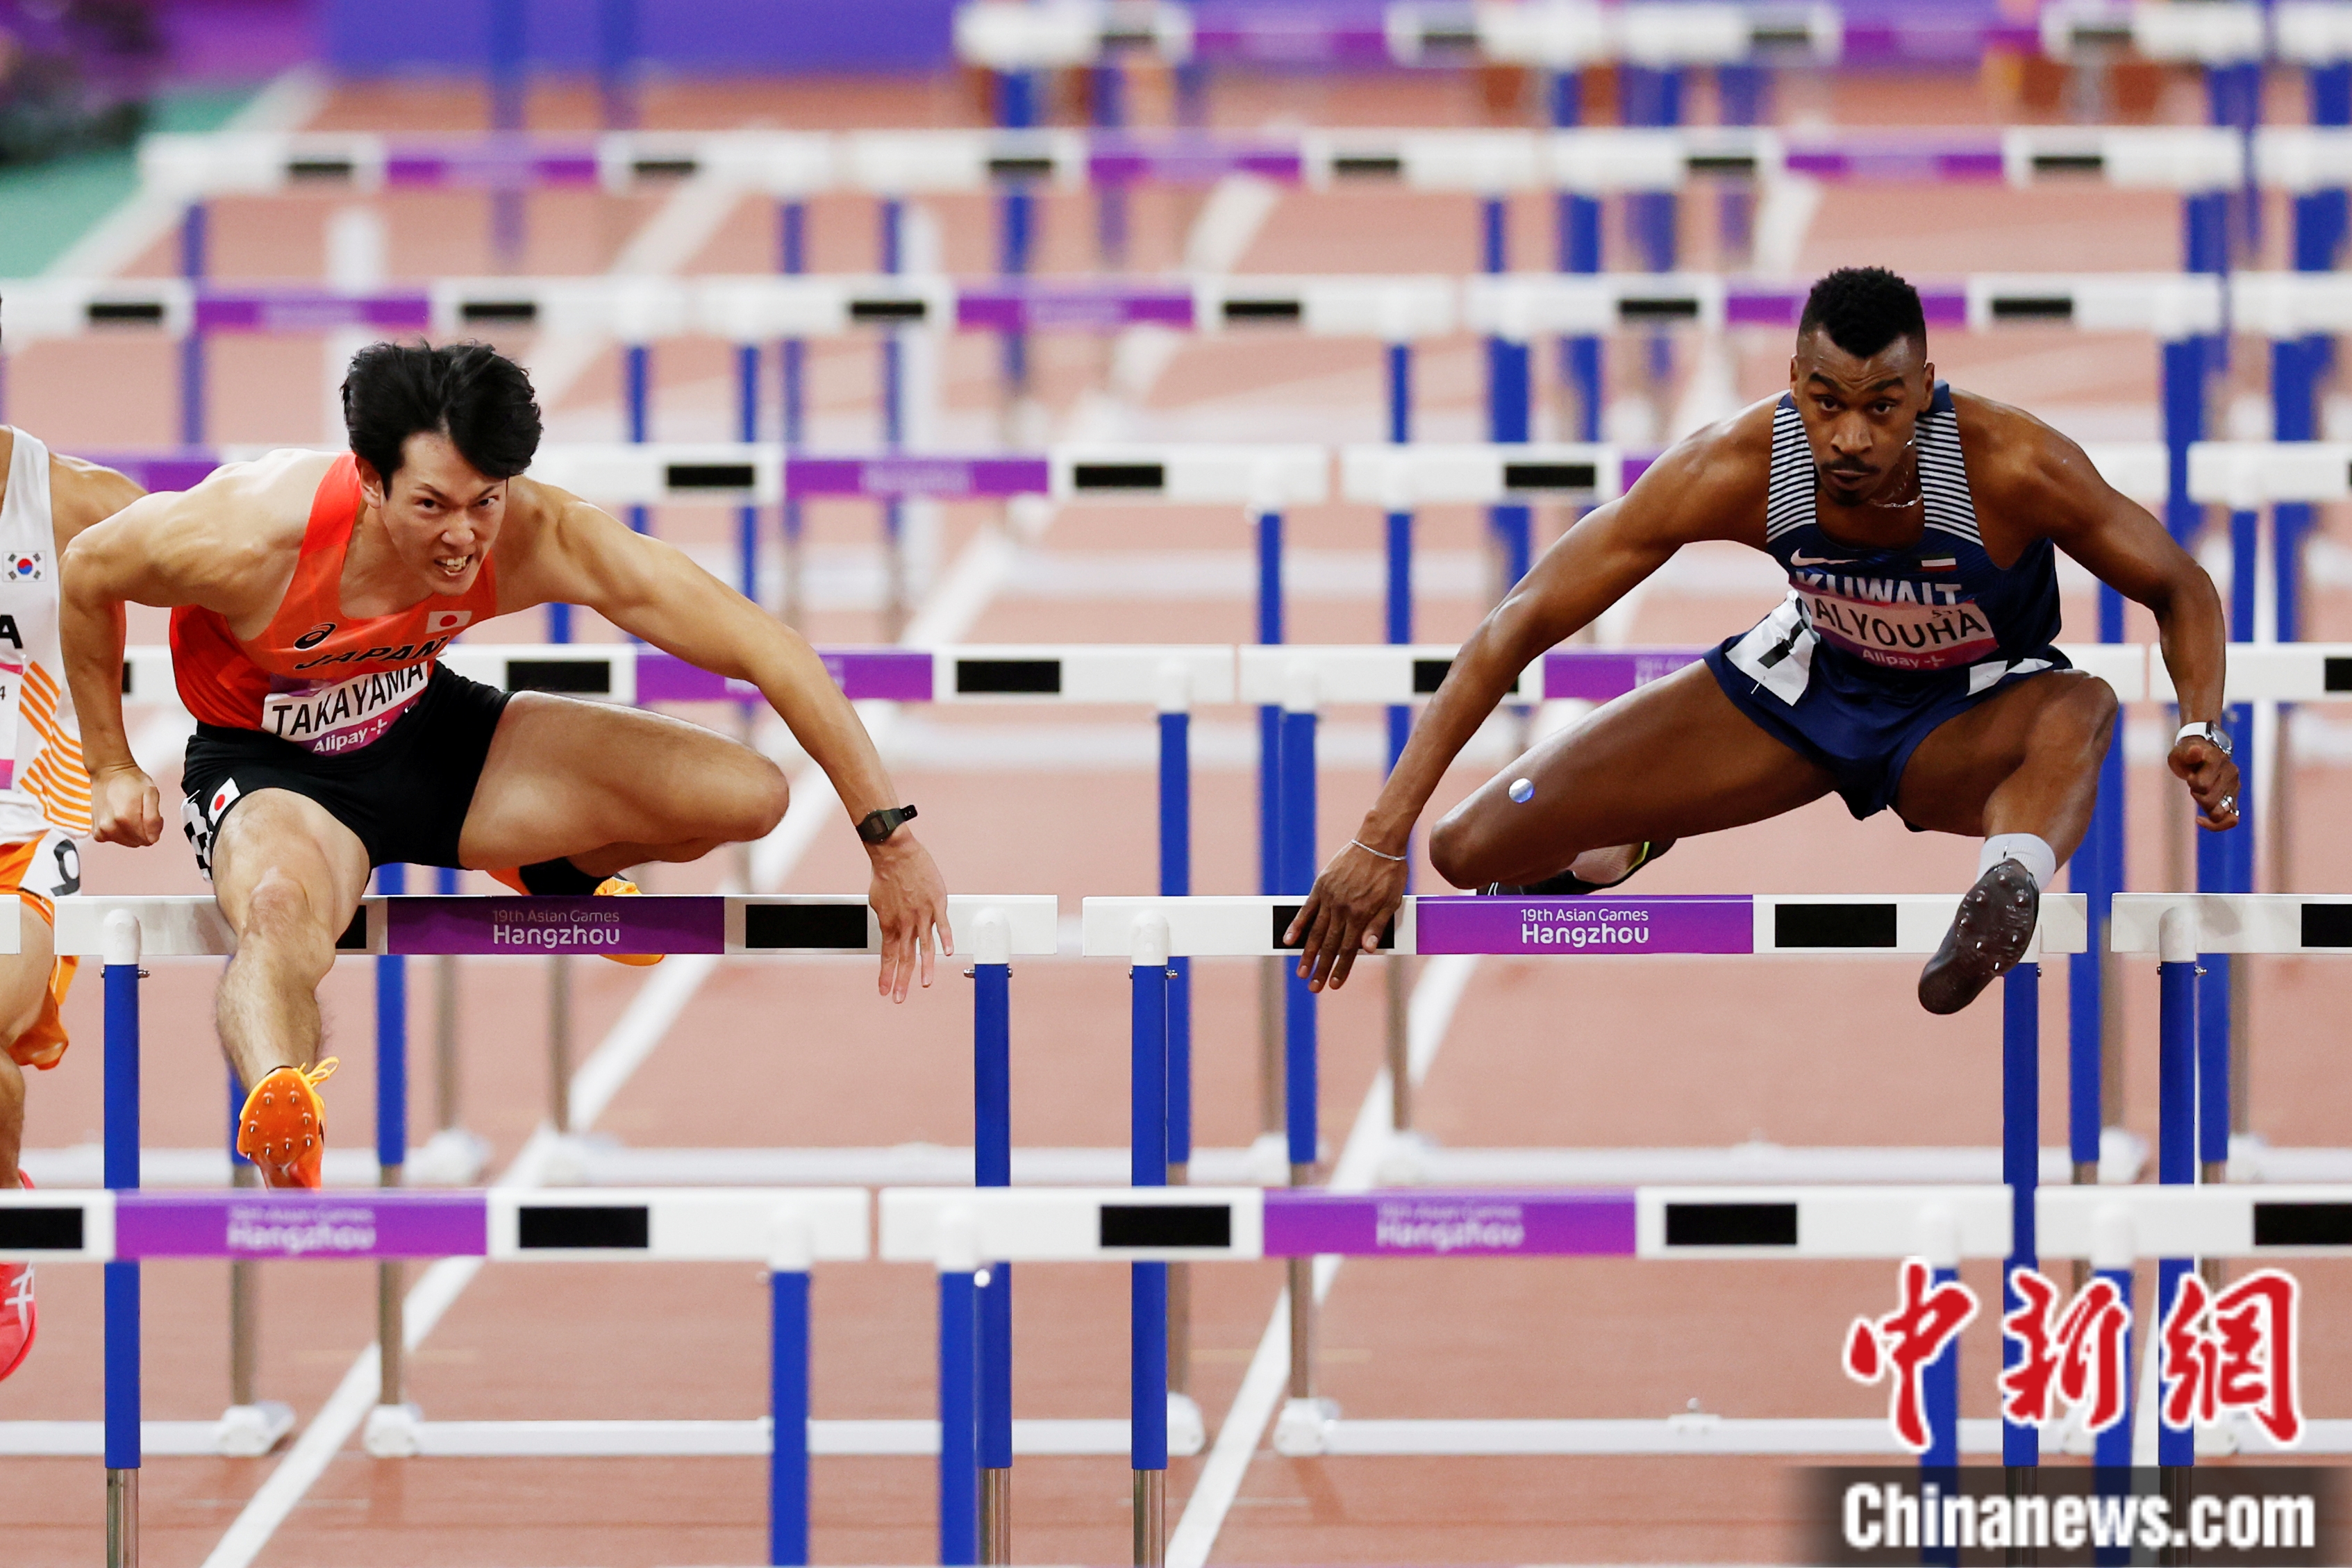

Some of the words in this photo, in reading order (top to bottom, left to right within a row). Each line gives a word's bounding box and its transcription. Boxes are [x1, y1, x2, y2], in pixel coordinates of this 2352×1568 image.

[1796, 571, 1962, 606] KUWAIT
[1814, 597, 1986, 649] ALYOUHA
[294, 635, 451, 670] JAPAN
[272, 662, 424, 736] TAKAYAMA
[492, 910, 524, 923] 19th
[526, 910, 567, 923] Asian
[569, 910, 620, 923] Games
[1520, 908, 1553, 921] 19th
[1556, 908, 1596, 921] Asian
[1598, 908, 1649, 921] Games
[492, 924, 620, 949] Hangzhou
[1521, 922, 1649, 948] Hangzhou
